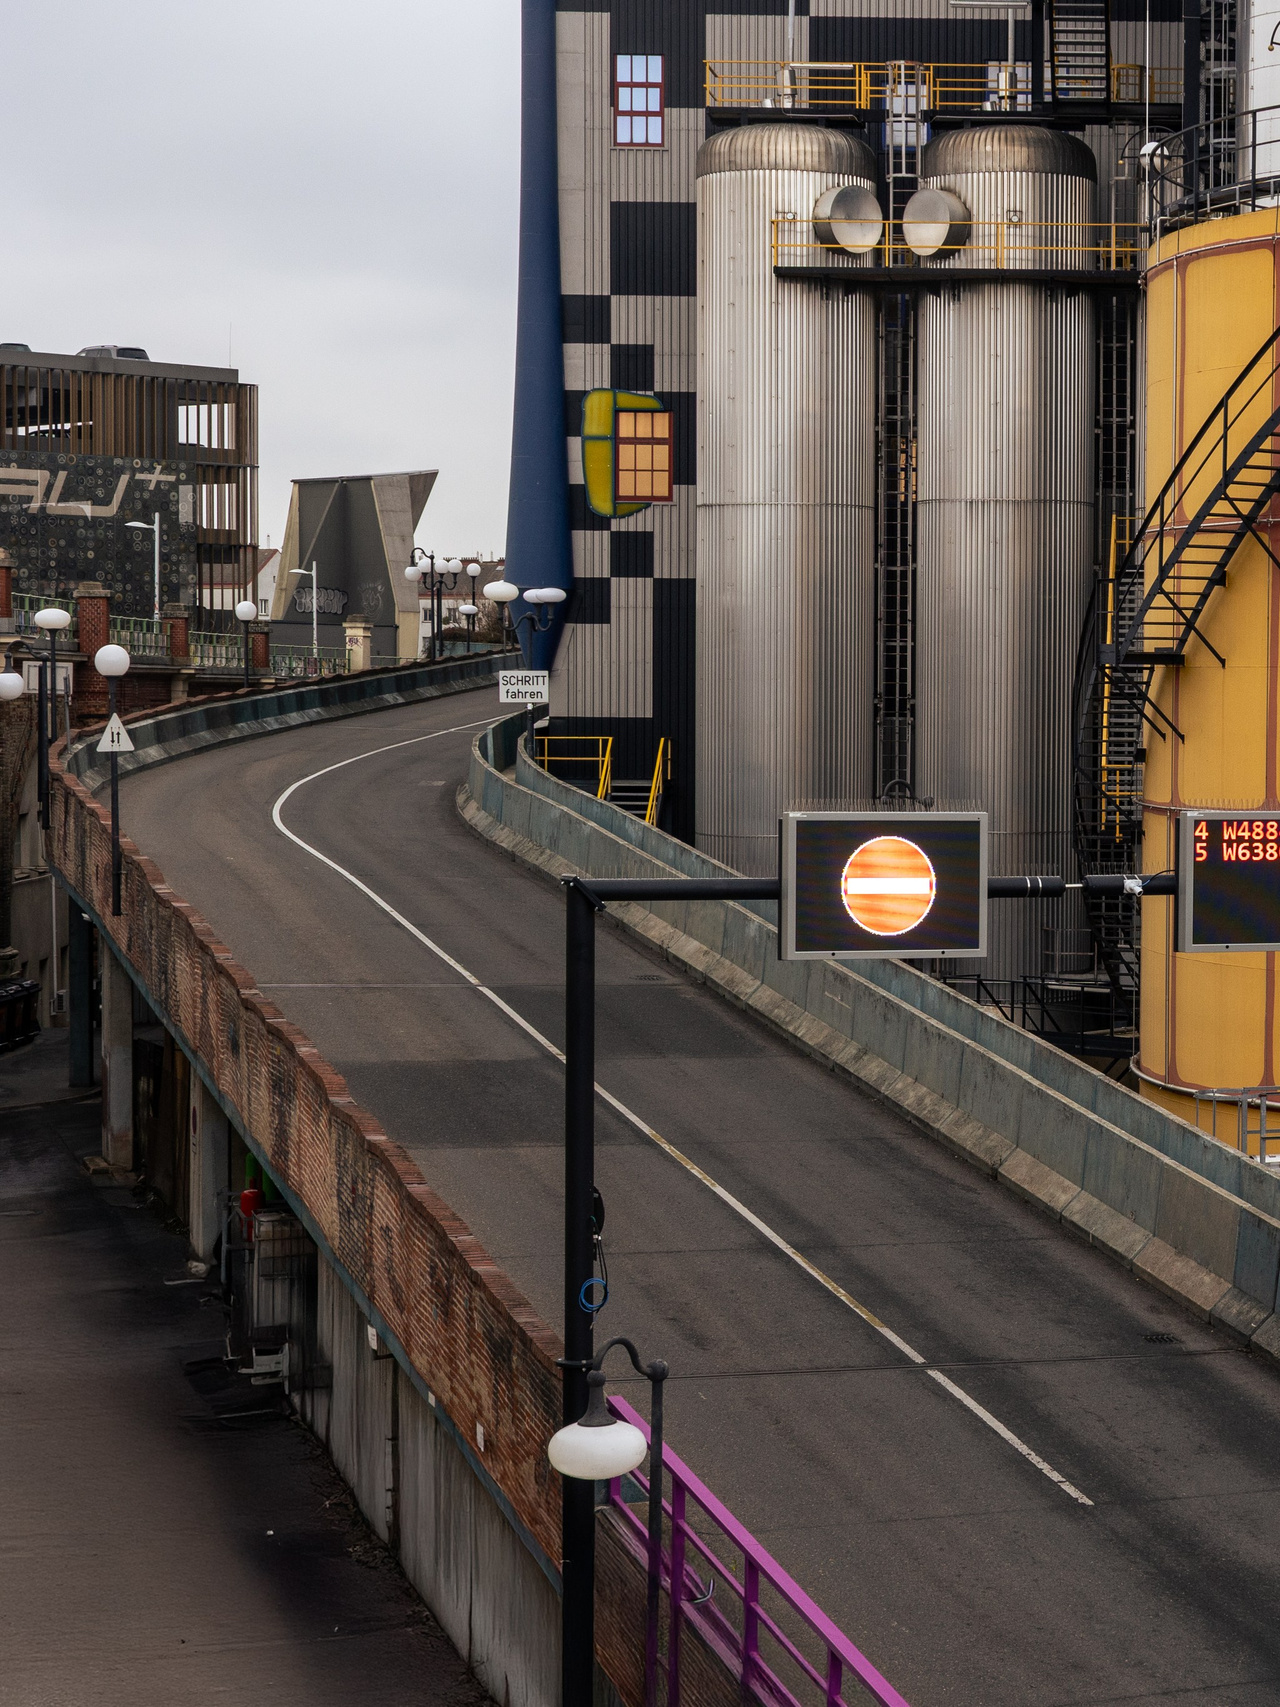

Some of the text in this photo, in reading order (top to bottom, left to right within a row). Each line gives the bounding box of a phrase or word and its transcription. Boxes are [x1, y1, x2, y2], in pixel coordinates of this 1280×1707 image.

[501, 675, 547, 686] SCHRITT
[505, 688, 543, 699] fahren
[1194, 821, 1209, 840] 4
[1195, 842, 1208, 862] 5
